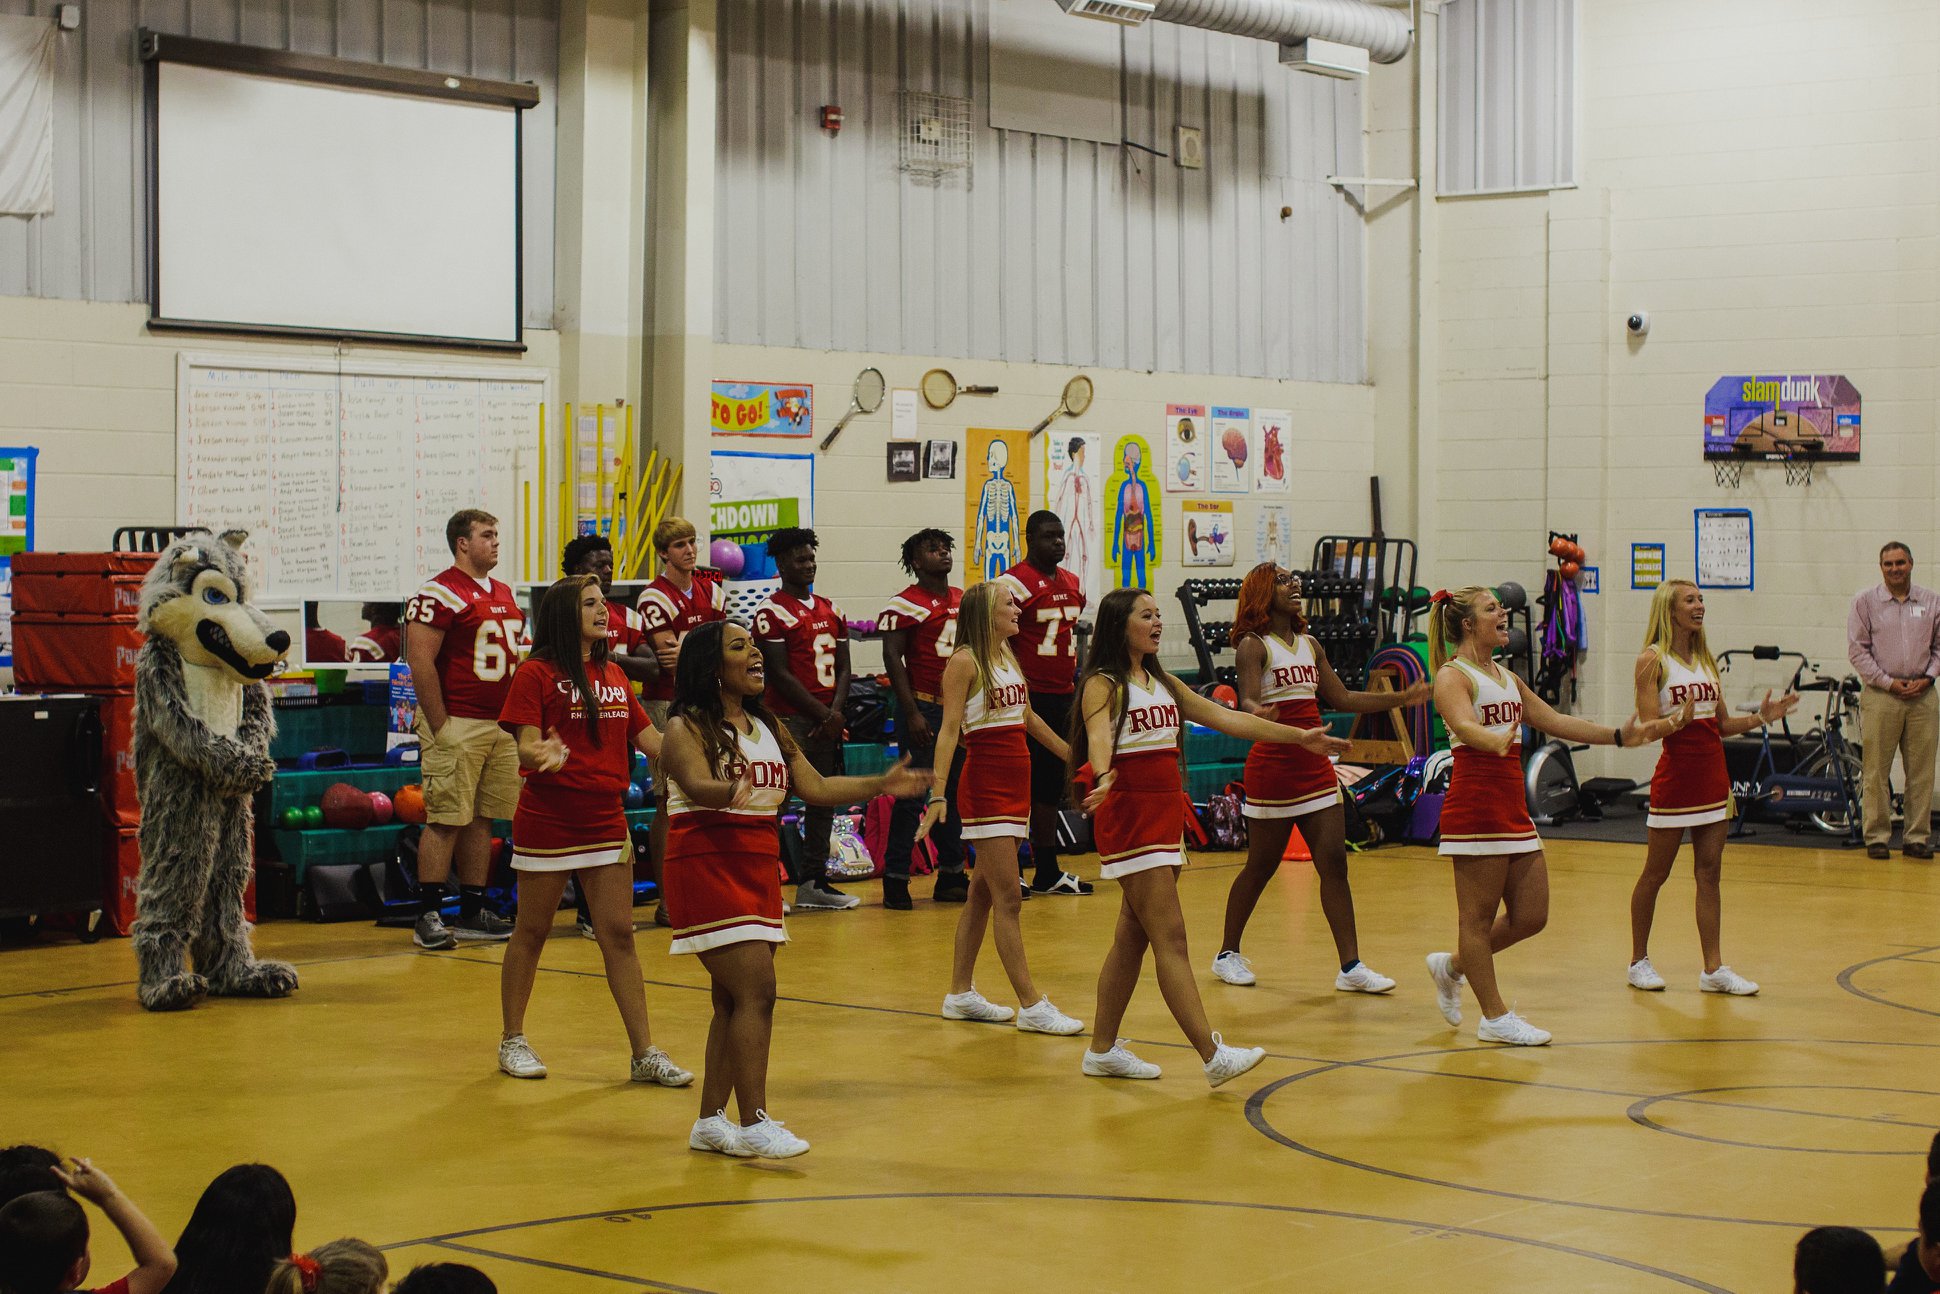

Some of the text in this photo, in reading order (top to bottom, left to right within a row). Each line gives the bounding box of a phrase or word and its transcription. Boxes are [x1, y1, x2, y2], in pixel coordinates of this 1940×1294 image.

[712, 400, 763, 426] TO GO!
[711, 503, 778, 530] CHDOWN
[406, 598, 436, 623] 65
[641, 604, 667, 631] 12
[756, 612, 771, 635] 6
[878, 614, 899, 631] 41
[607, 630, 619, 638] ME
[934, 618, 958, 658] 4
[1036, 606, 1081, 657] 77
[473, 618, 523, 682] 65
[812, 633, 837, 688] 6
[557, 679, 628, 703] Wlve
[988, 683, 1027, 710] ROM
[1669, 681, 1721, 706] ROM
[1127, 703, 1180, 734] ROM
[1481, 701, 1523, 726] ROM
